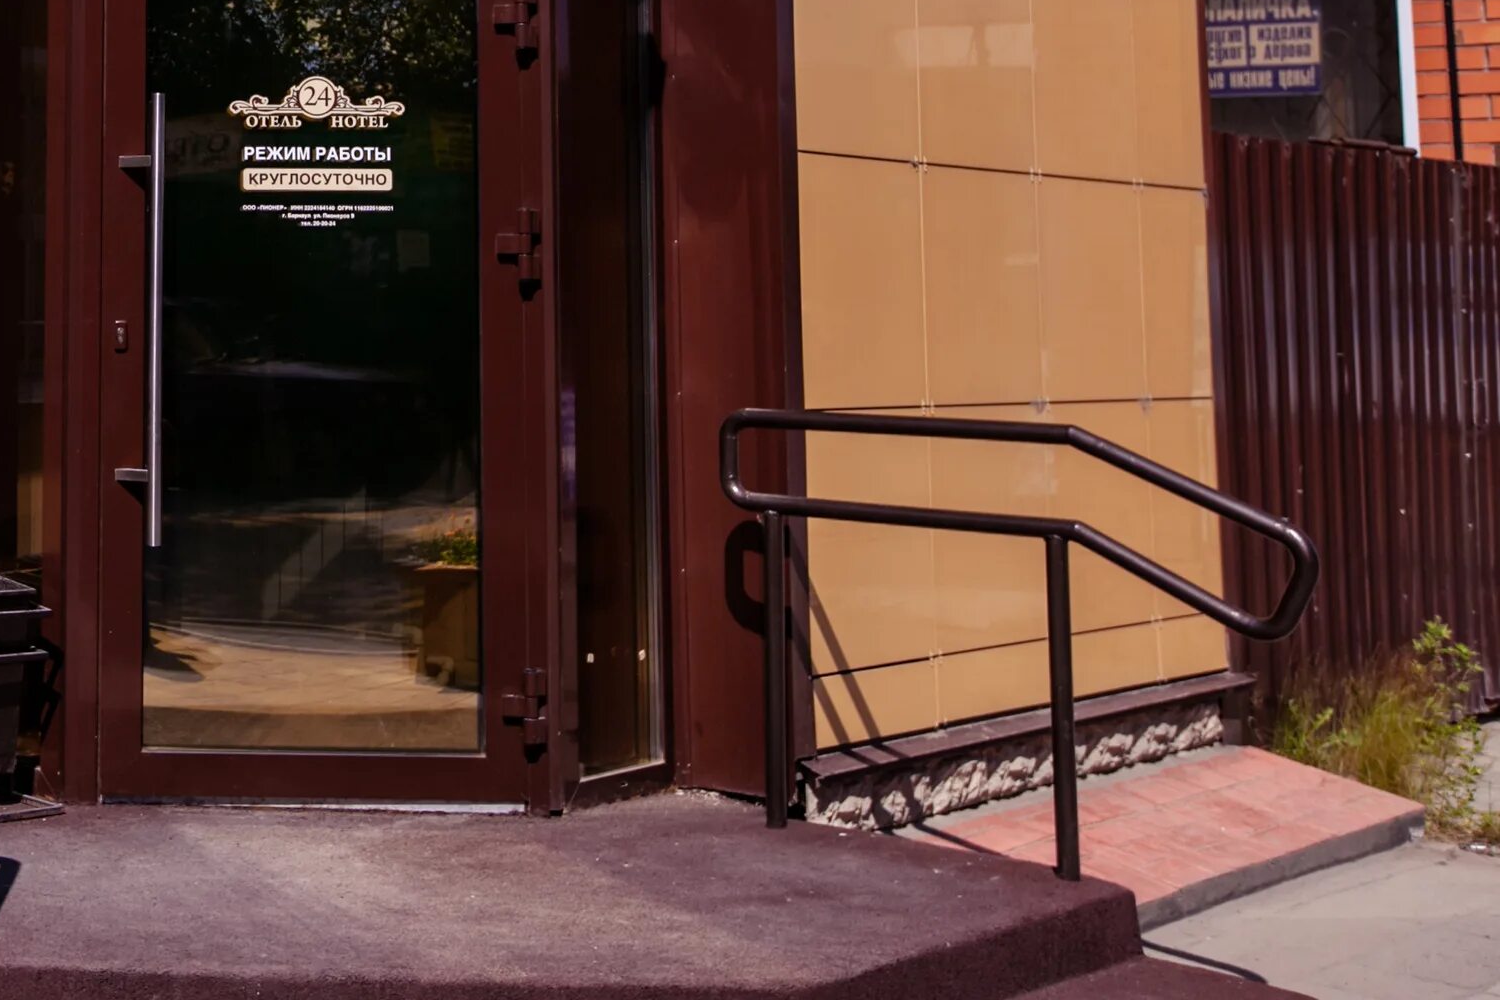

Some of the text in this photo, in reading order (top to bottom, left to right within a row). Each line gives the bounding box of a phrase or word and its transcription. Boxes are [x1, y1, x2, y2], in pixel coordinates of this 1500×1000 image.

[303, 86, 332, 106] 24
[245, 115, 302, 129] ОТЕЛЬ
[331, 115, 389, 129] HOTEL
[243, 146, 311, 162] РЕЖИМ
[315, 146, 392, 162] РАБОТЫ
[248, 172, 388, 187] КРУГЛОСУТОЧНО
